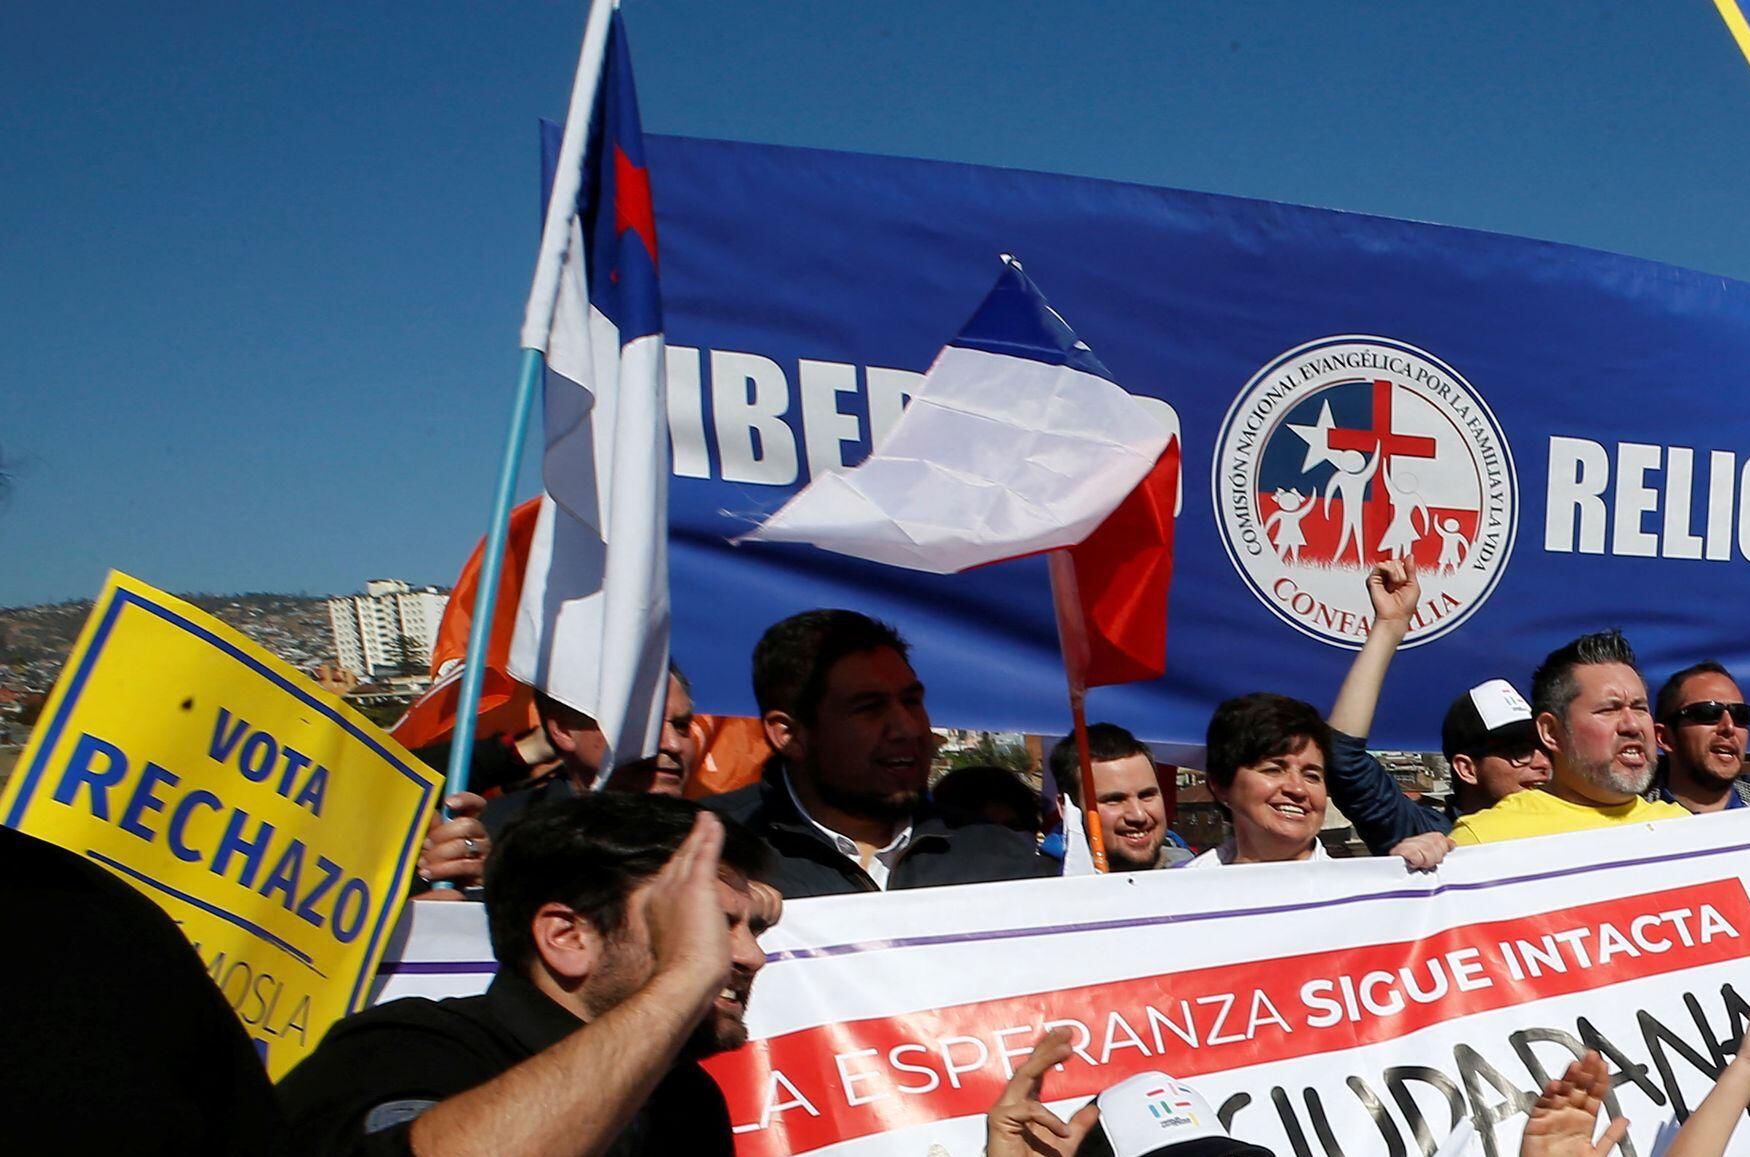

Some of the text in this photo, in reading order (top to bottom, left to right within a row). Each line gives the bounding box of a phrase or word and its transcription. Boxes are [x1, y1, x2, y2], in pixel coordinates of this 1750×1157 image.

[1228, 348, 1505, 572] COMISIÓN NACIONAL EVANGÉLICA POR LA FAMILIA Y LA VIDA
[1273, 577, 1462, 638] CONFALIA
[207, 707, 331, 819] VOTA
[52, 732, 371, 945] RECHAZO
[1298, 947, 1503, 1027] SIGUE
[1500, 902, 1740, 982] INTACTA
